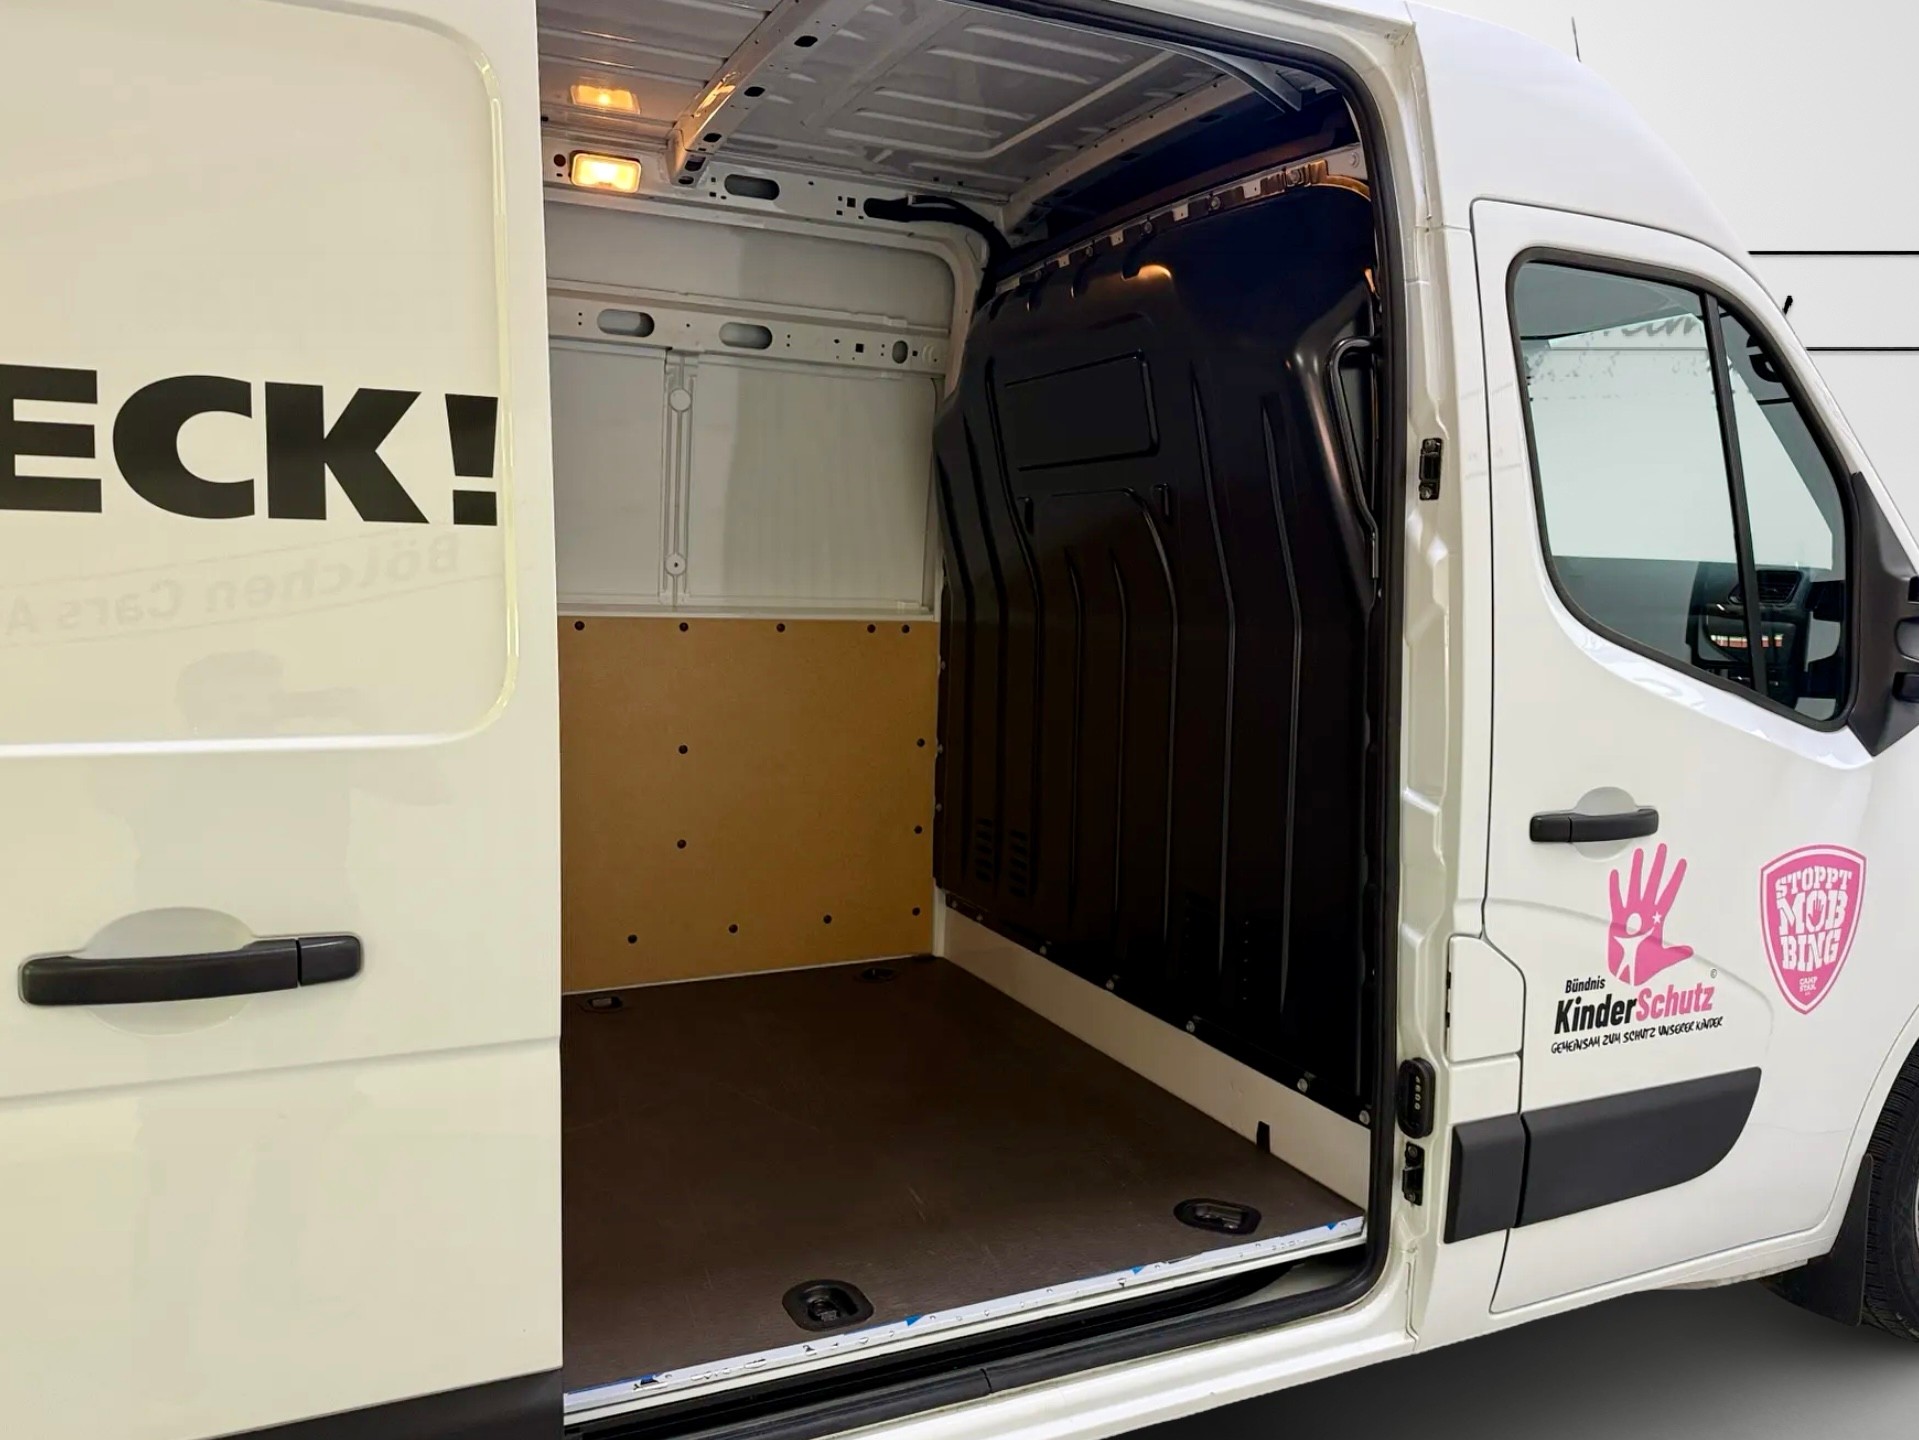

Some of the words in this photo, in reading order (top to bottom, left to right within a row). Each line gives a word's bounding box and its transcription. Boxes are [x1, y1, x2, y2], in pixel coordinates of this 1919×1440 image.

[0, 364, 499, 526] ECK!
[1775, 865, 1853, 899] STOPPT
[1776, 889, 1848, 936] MOB
[1780, 927, 1842, 972] BING
[1565, 975, 1606, 993] Bündnis
[1554, 982, 1715, 1034] KinderSchutz
[1602, 1031, 1621, 1046] ZUM
[1622, 1026, 1656, 1043] SCHUTZ
[1658, 1021, 1695, 1037] UNSERER
